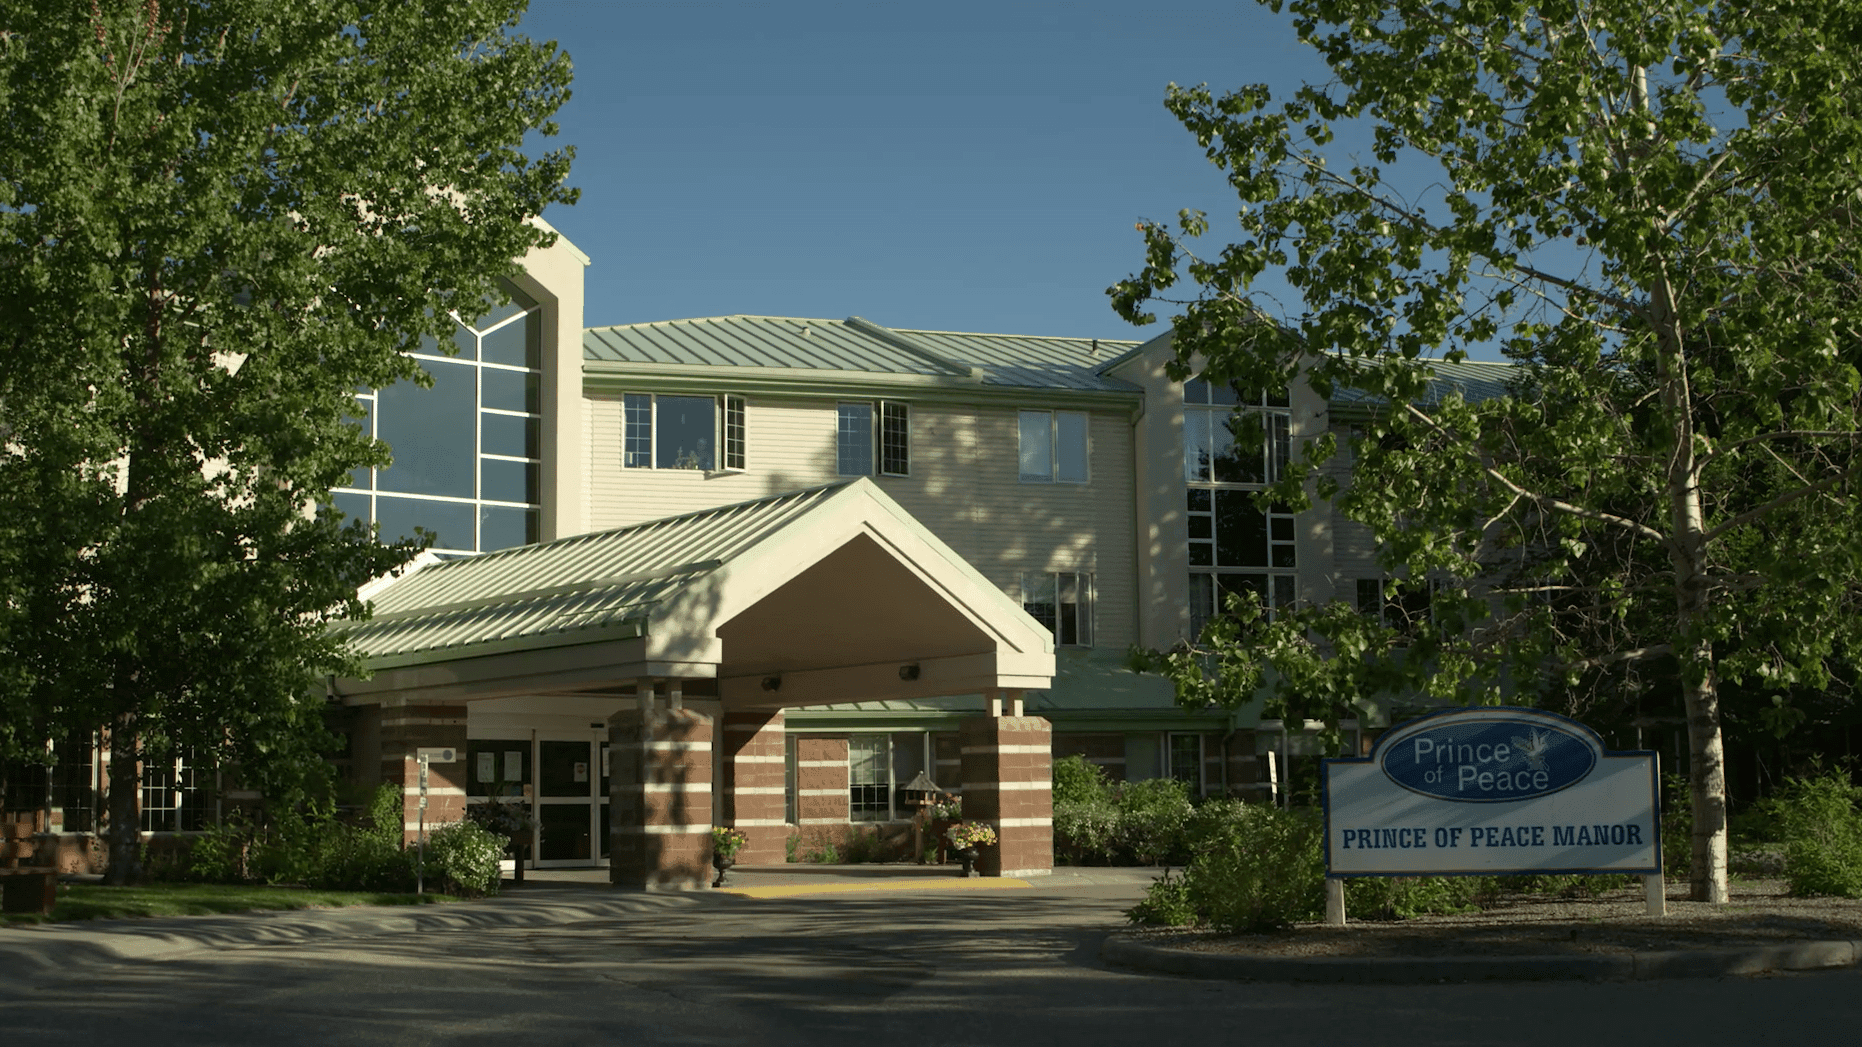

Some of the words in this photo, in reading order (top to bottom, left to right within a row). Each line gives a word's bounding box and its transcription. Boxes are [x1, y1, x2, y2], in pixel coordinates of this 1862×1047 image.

[1413, 738, 1511, 764] Prince
[1424, 767, 1443, 784] of
[1457, 765, 1549, 791] Peace
[1342, 827, 1427, 849] PRINCE
[1434, 827, 1462, 848] OF
[1470, 825, 1545, 847] PEACE
[1552, 824, 1643, 846] MANOR
